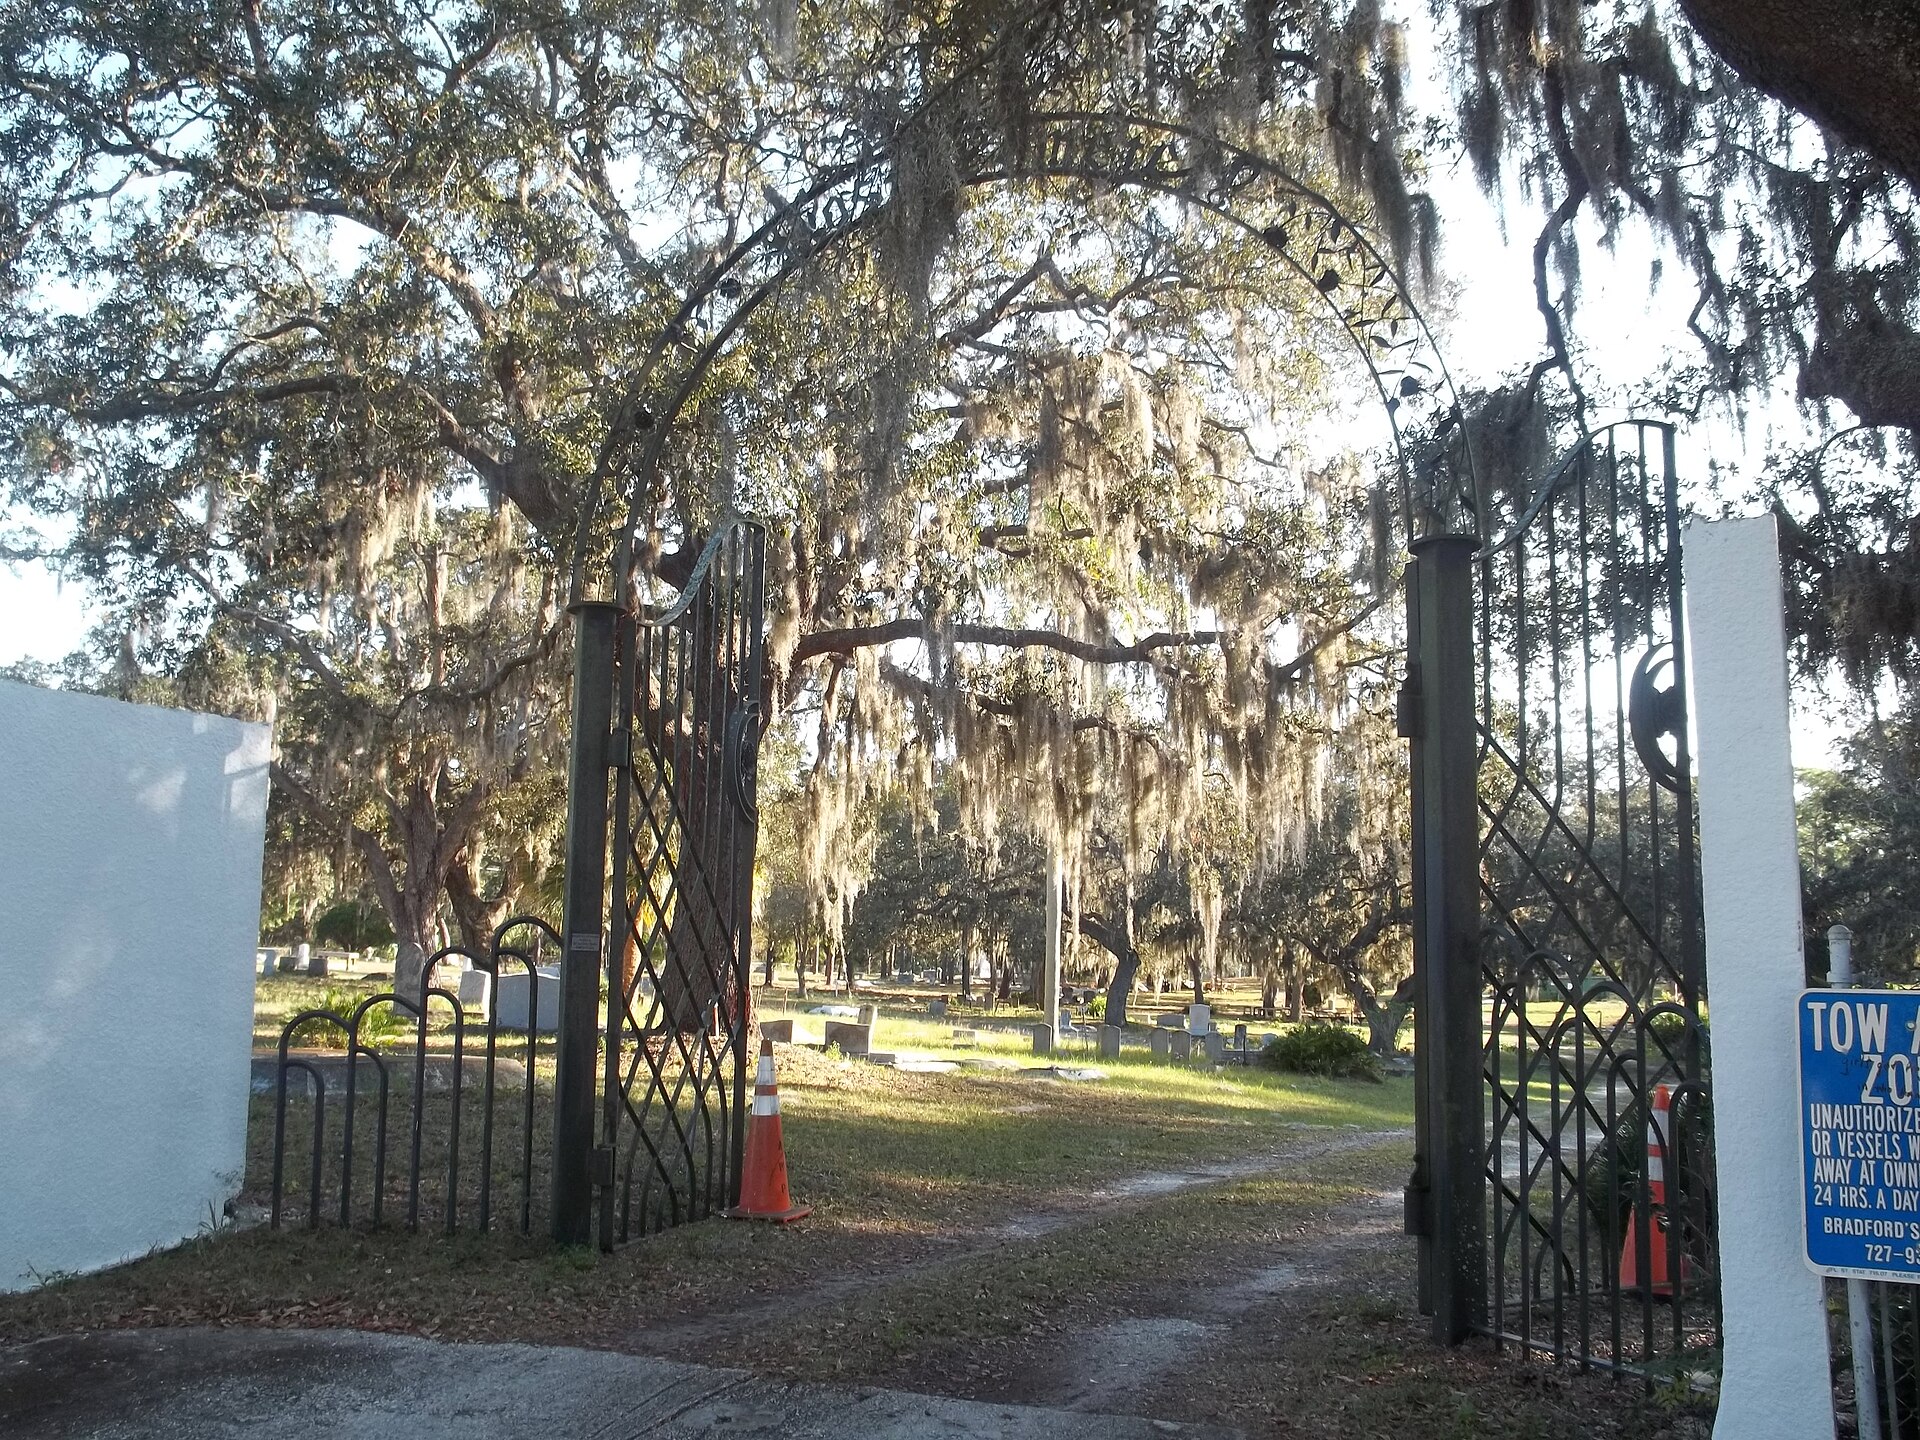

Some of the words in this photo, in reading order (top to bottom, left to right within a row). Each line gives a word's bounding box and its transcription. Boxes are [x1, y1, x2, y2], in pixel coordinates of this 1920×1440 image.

[1807, 1001, 1888, 1053] TOW
[1861, 1053, 1920, 1106] ZO
[1812, 1129, 1831, 1156] OR
[1837, 1131, 1901, 1160] VESSELS
[1813, 1157, 1852, 1184] AWAY
[1859, 1159, 1876, 1186] AT
[1883, 1160, 1920, 1188] OWN
[1813, 1184, 1832, 1206] 24
[1839, 1186, 1872, 1209] HRS.
[1876, 1188, 1887, 1210] A
[1892, 1189, 1919, 1212] DAY
[1823, 1216, 1920, 1240] BRADFORD'S
